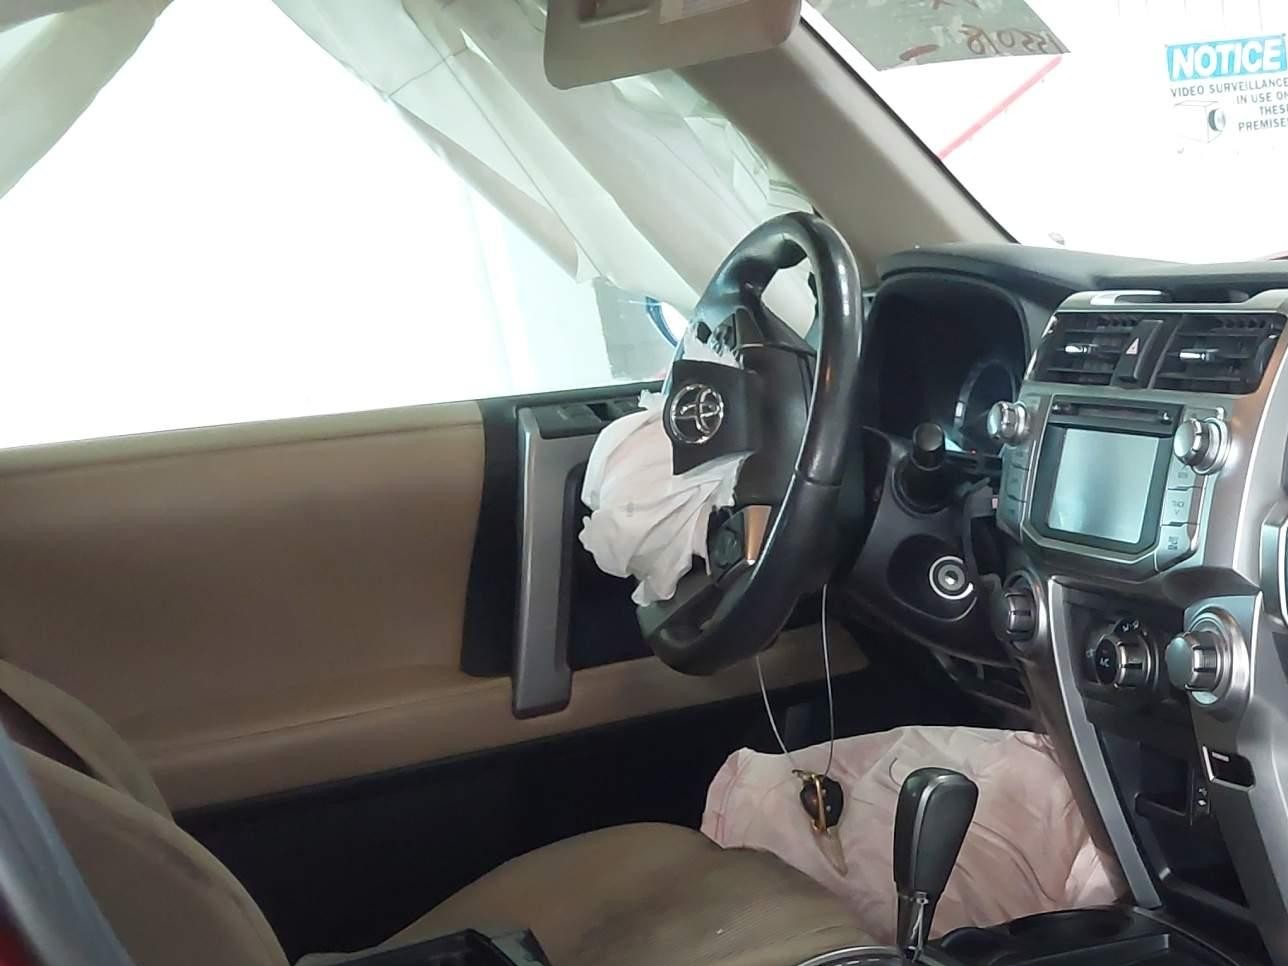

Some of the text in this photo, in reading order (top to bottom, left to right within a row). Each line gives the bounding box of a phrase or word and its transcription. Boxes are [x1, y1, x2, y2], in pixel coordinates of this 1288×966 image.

[1171, 39, 1283, 81] NOTICE
[1170, 77, 1288, 98] VIDEO SURVEILLANCE
[1236, 95, 1248, 105] IN
[1250, 92, 1272, 104] USE
